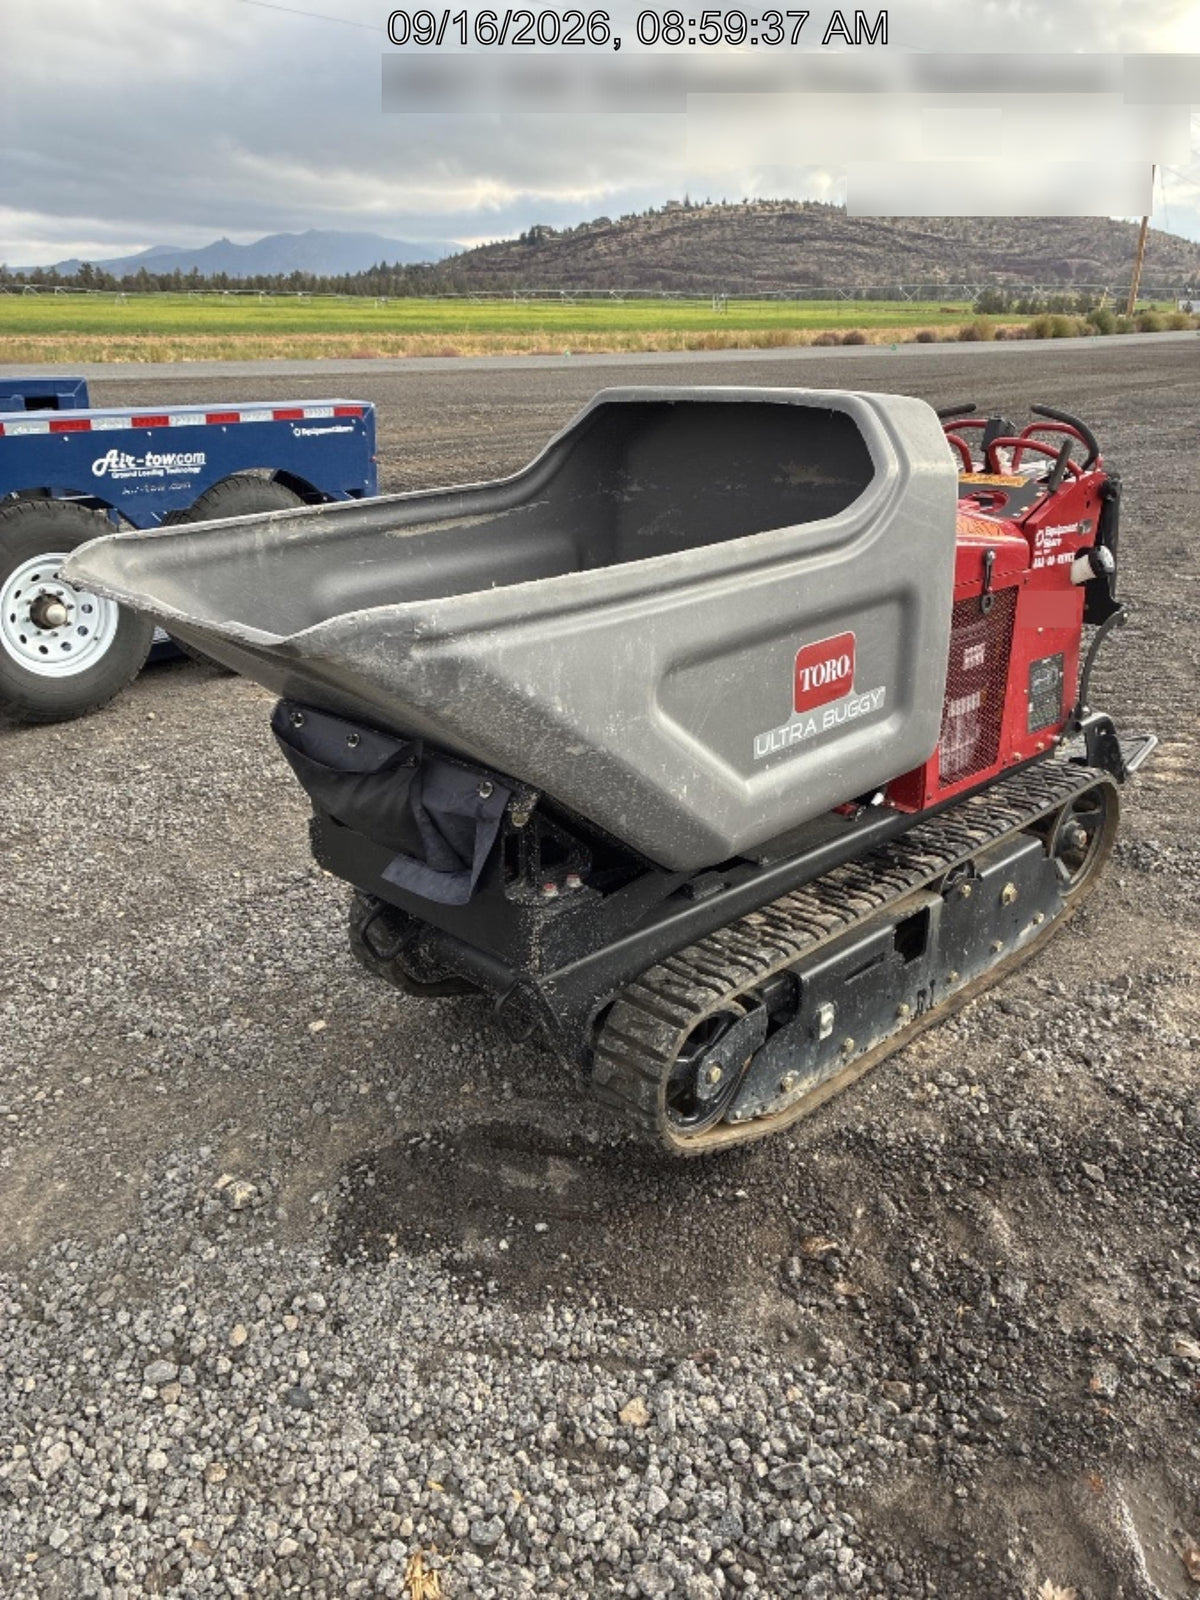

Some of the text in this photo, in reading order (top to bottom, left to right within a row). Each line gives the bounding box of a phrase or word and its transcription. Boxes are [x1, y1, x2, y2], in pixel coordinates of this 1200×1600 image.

[92, 449, 206, 477] Air-tow.com
[111, 471, 137, 479] Ground
[138, 469, 164, 477] Loading
[800, 654, 851, 692] TORO
[756, 691, 881, 755] ULTRA BUGGY
